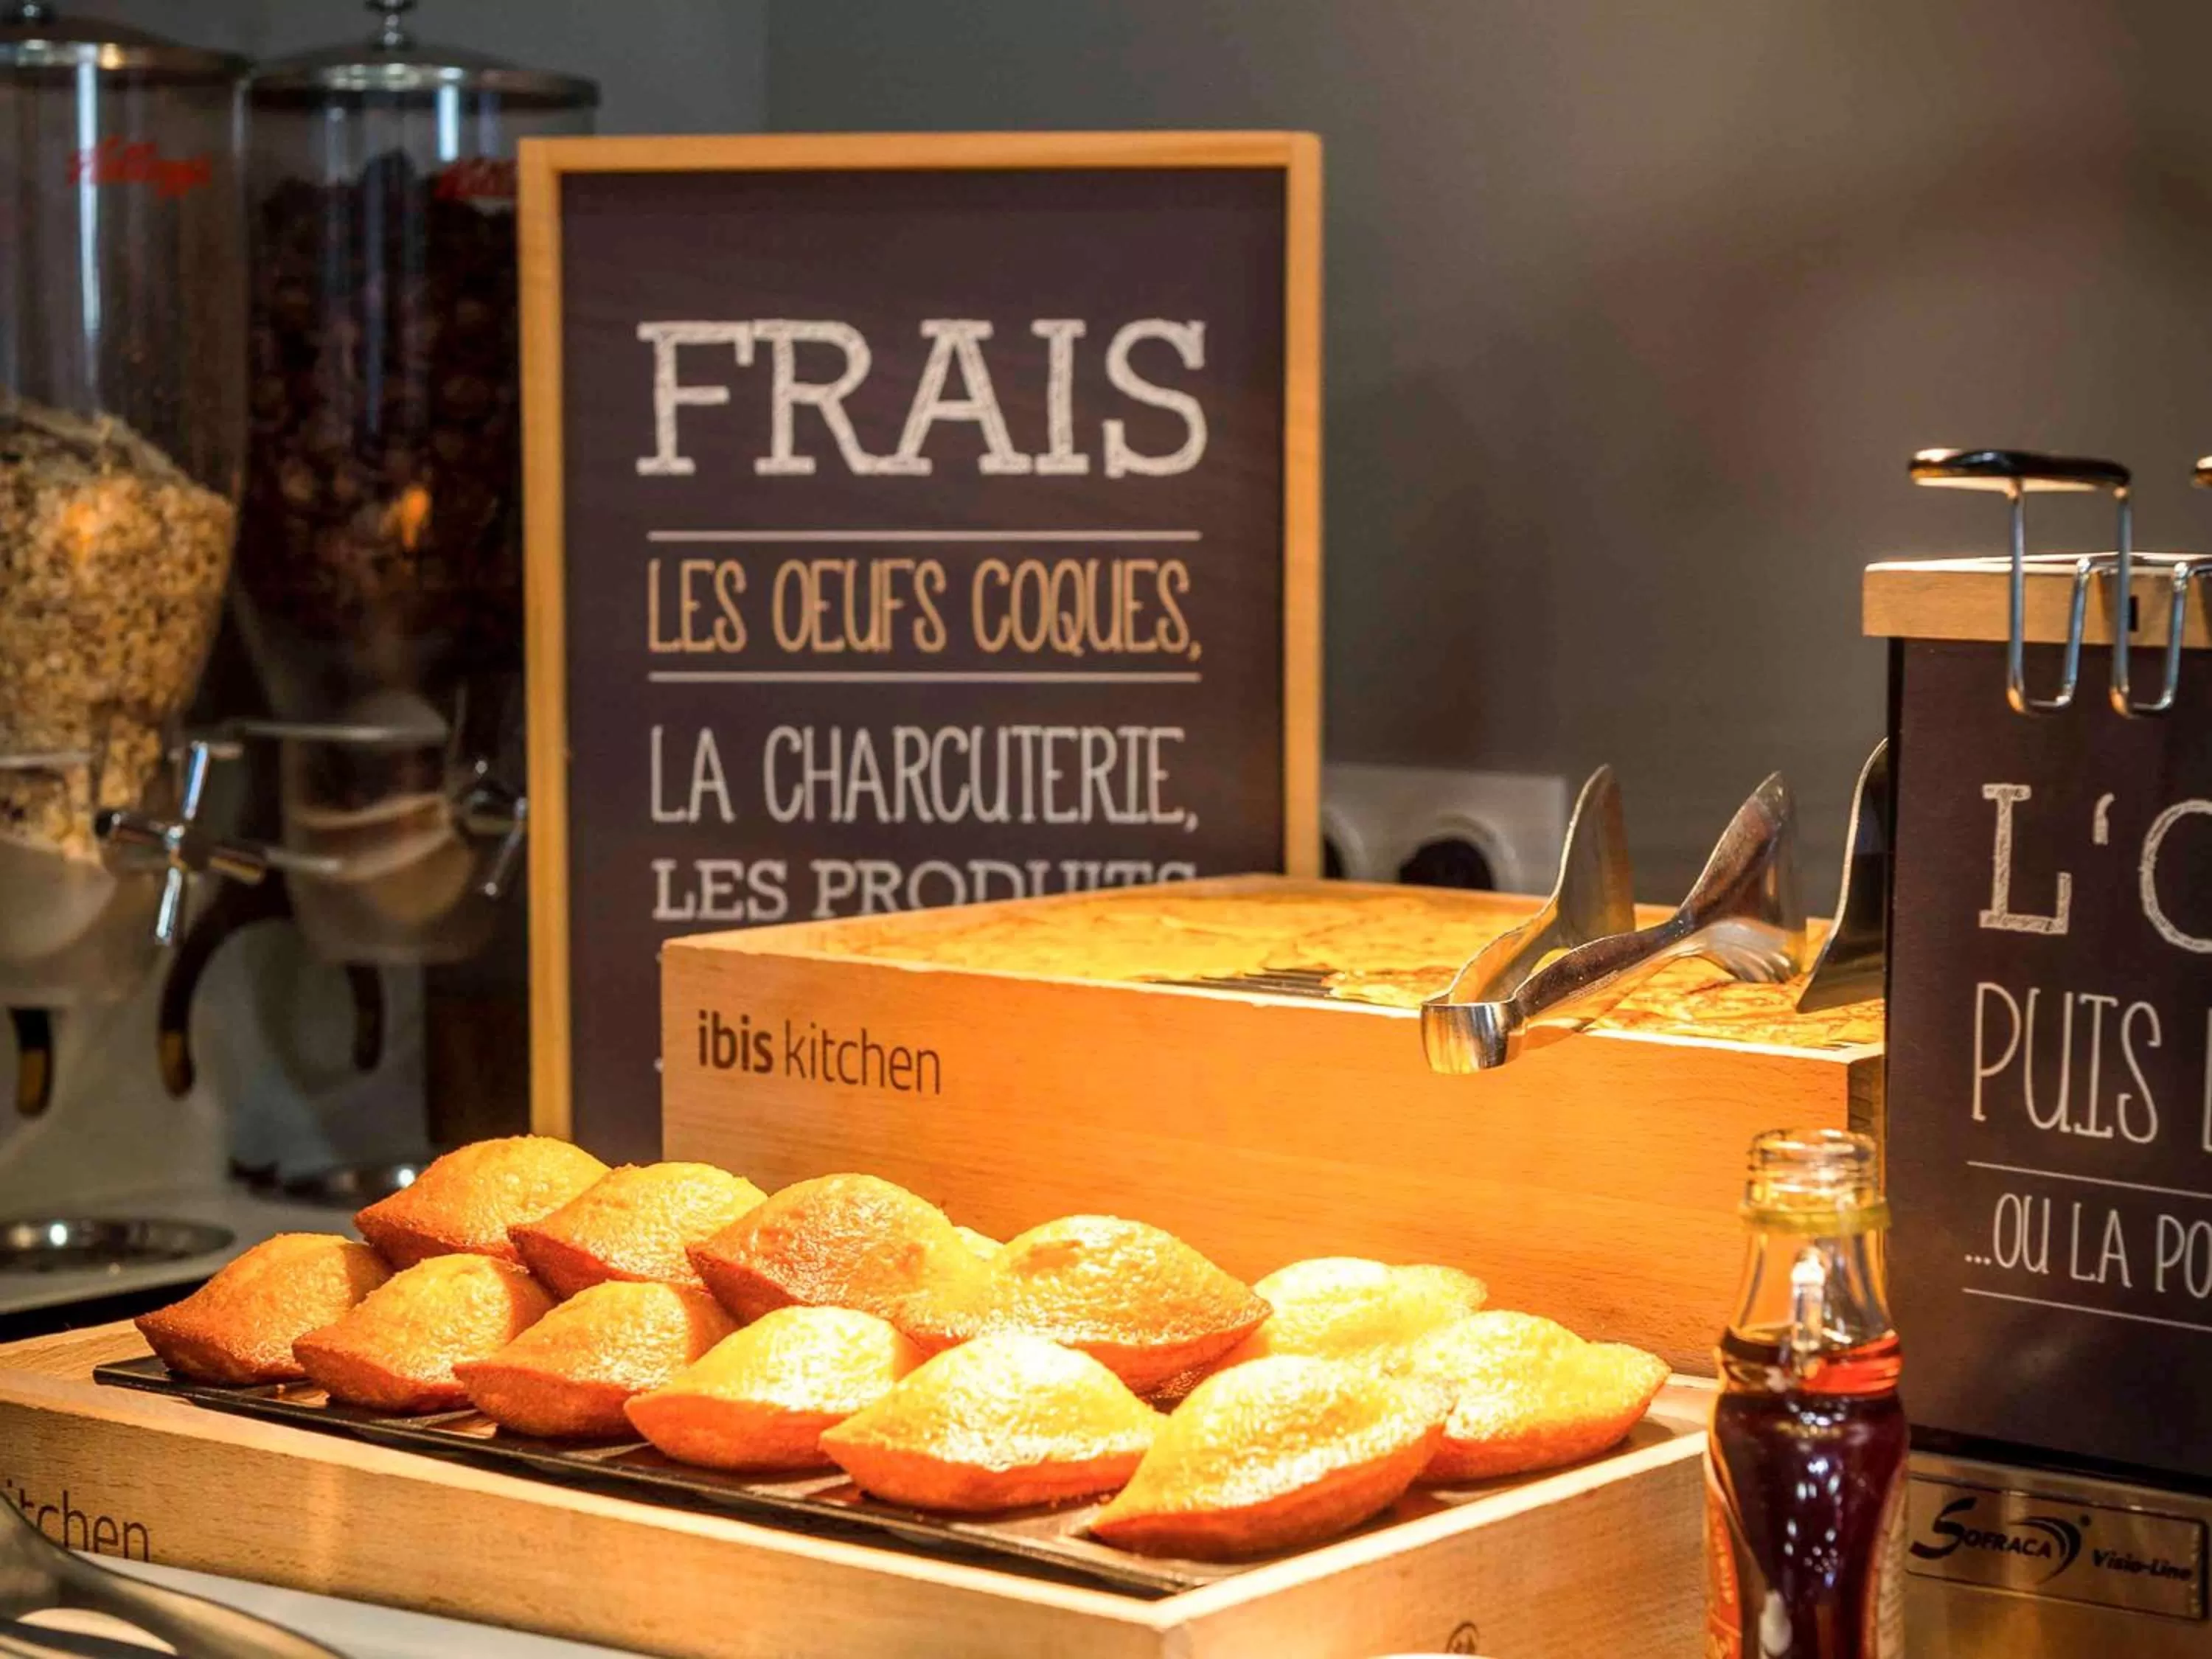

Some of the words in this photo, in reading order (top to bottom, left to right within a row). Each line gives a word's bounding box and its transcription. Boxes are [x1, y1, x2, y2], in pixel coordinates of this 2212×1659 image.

[636, 319, 1208, 478] FRAIS
[648, 559, 747, 653] LES
[972, 558, 1202, 662] COQUES,
[651, 725, 735, 823] LA
[763, 725, 1199, 832] CHARCUTERIE,
[651, 859, 788, 920] LES
[698, 1009, 774, 1074] ibis
[785, 1018, 942, 1095] kitchen
[1971, 981, 2162, 1144] PUIS
[2070, 1202, 2132, 1289] LA
